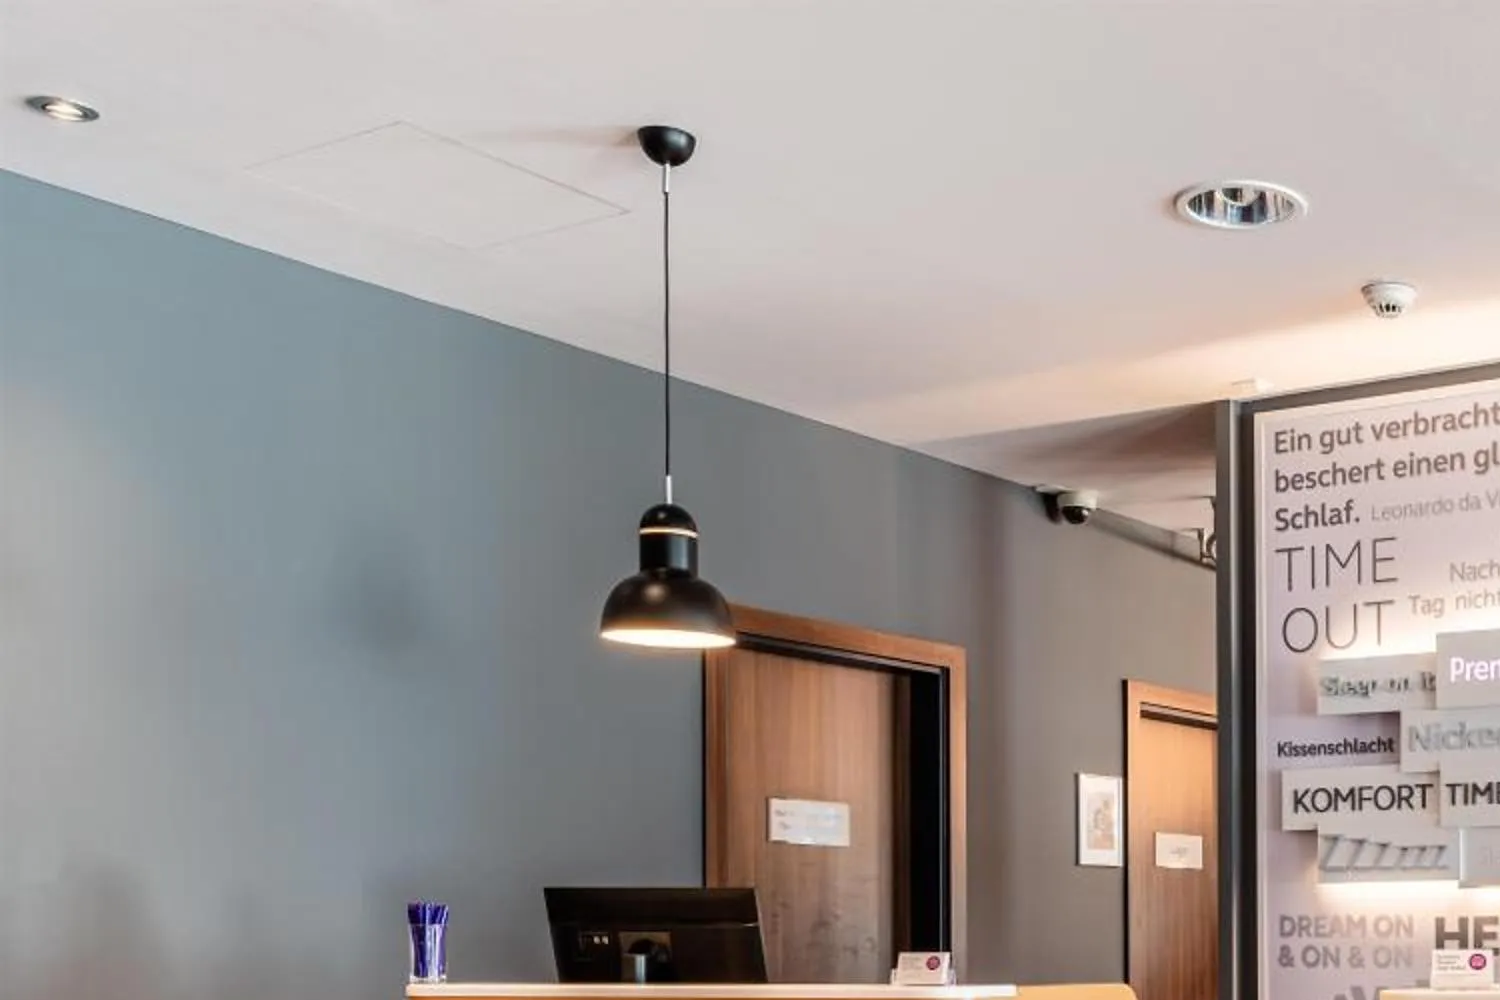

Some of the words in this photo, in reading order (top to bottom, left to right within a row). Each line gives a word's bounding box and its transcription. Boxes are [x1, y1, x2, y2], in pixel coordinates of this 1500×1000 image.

[1274, 428, 1312, 454] Ein
[1319, 421, 1364, 454] gut
[1275, 458, 1385, 493] beschert
[1392, 451, 1465, 478] einen
[1275, 499, 1360, 532] Schlaf.
[1371, 497, 1454, 521] Leonardo
[1458, 491, 1482, 512] da
[1275, 537, 1398, 592] TIME
[1407, 594, 1446, 619] Tag
[1282, 599, 1395, 653] OUT
[1277, 736, 1395, 758] Kissenschlacht
[1292, 783, 1434, 815] KOMFORT
[1278, 914, 1367, 939] DREAM
[1373, 914, 1414, 938] ON
[1277, 944, 1296, 969] &
[1301, 944, 1341, 969] ON
[1347, 945, 1366, 969] &
[1372, 944, 1414, 969] ON
